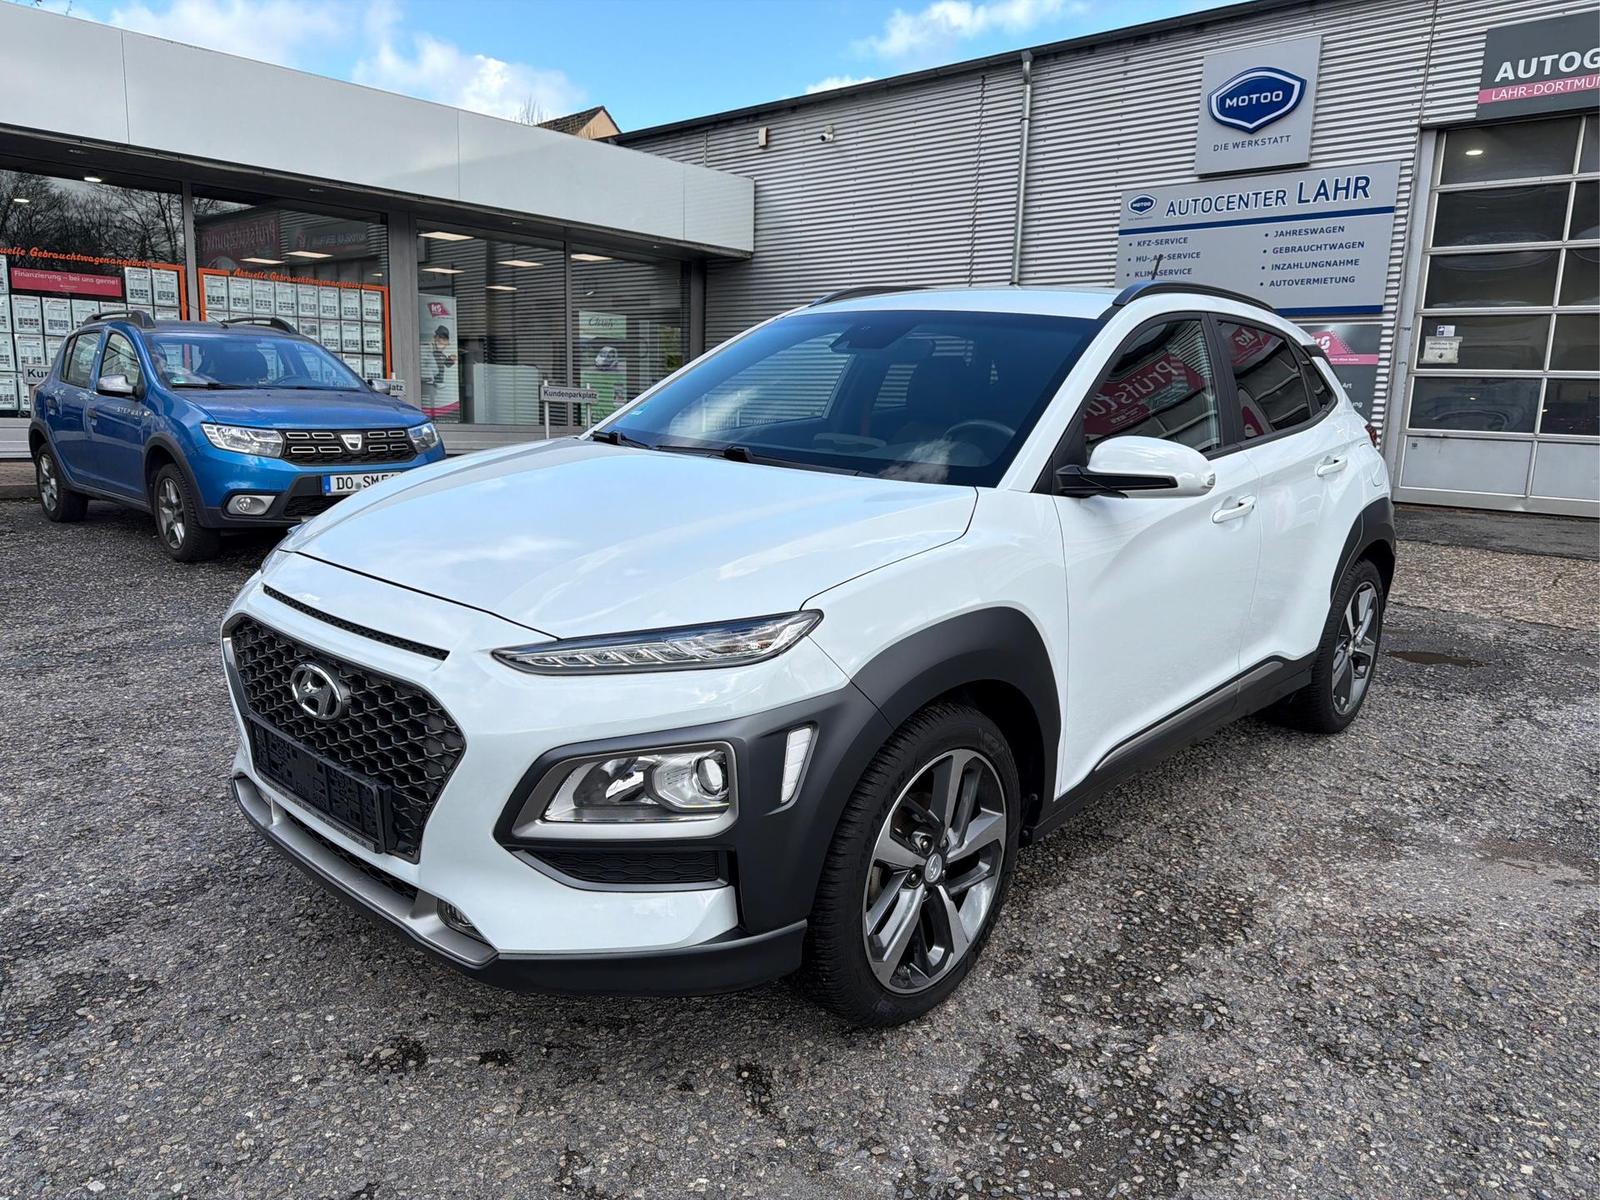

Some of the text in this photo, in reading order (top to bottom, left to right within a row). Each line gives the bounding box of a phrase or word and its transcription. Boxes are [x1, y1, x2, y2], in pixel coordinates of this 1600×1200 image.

[1494, 47, 1600, 82] AUTOG
[1225, 90, 1284, 109] MOTOO
[1213, 135, 1292, 152] DIE WERKSTATT
[1164, 175, 1371, 217] AUTOCENTER LAHR
[1273, 226, 1345, 238] JAHRESWAGEN
[1136, 237, 1189, 247] KFZ-SERVICE
[1272, 241, 1365, 254] GEBRAUCHTWAGEN
[1271, 259, 1360, 271] INZAHLUNGNAHME
[14, 270, 62, 282] Finanzierung
[1269, 276, 1356, 288] AUTOVERMIETUNG
[543, 389, 598, 399] Kundenparkplatz
[335, 476, 354, 490] DO
